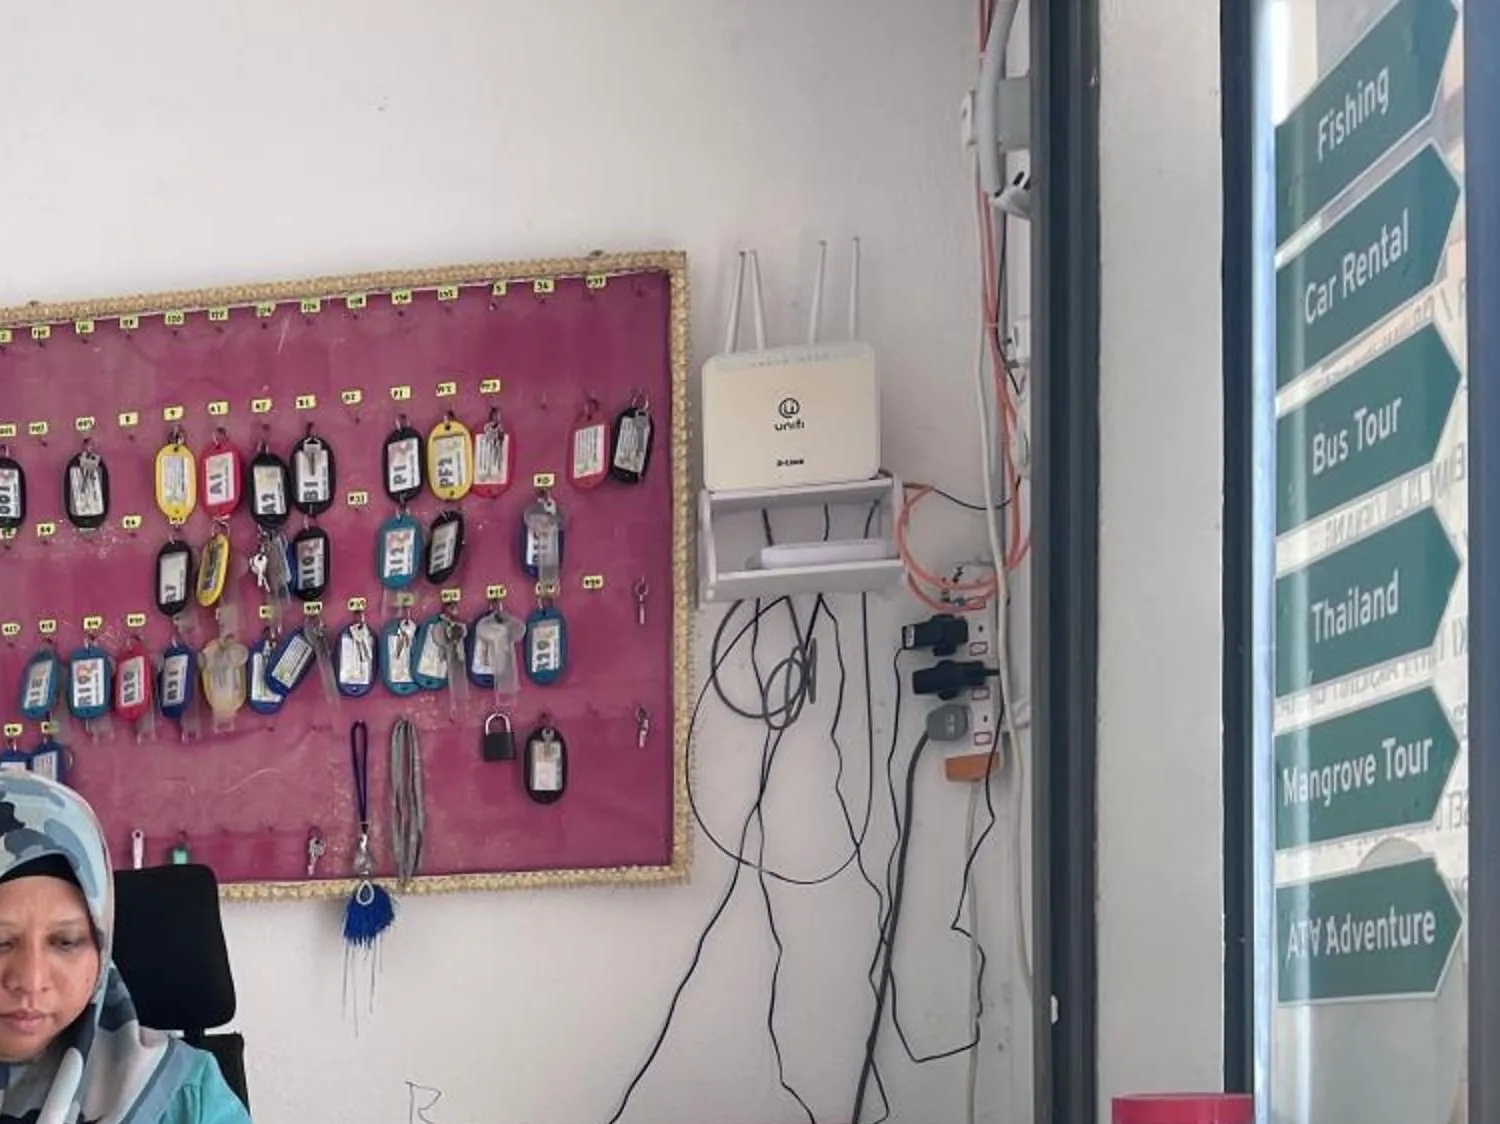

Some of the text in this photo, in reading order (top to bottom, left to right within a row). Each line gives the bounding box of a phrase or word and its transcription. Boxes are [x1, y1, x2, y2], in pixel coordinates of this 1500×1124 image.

[1317, 66, 1390, 161] Fishing
[1305, 208, 1409, 324] Car Rental
[1313, 397, 1402, 475] Bus Tour
[210, 473, 222, 495] A1
[261, 494, 275, 514] A2
[303, 481, 318, 501] B1
[394, 464, 406, 484] P1
[1312, 567, 1399, 643] Thailand
[1282, 736, 1432, 807] Mangrove Tour
[1326, 904, 1436, 955] Adventure
